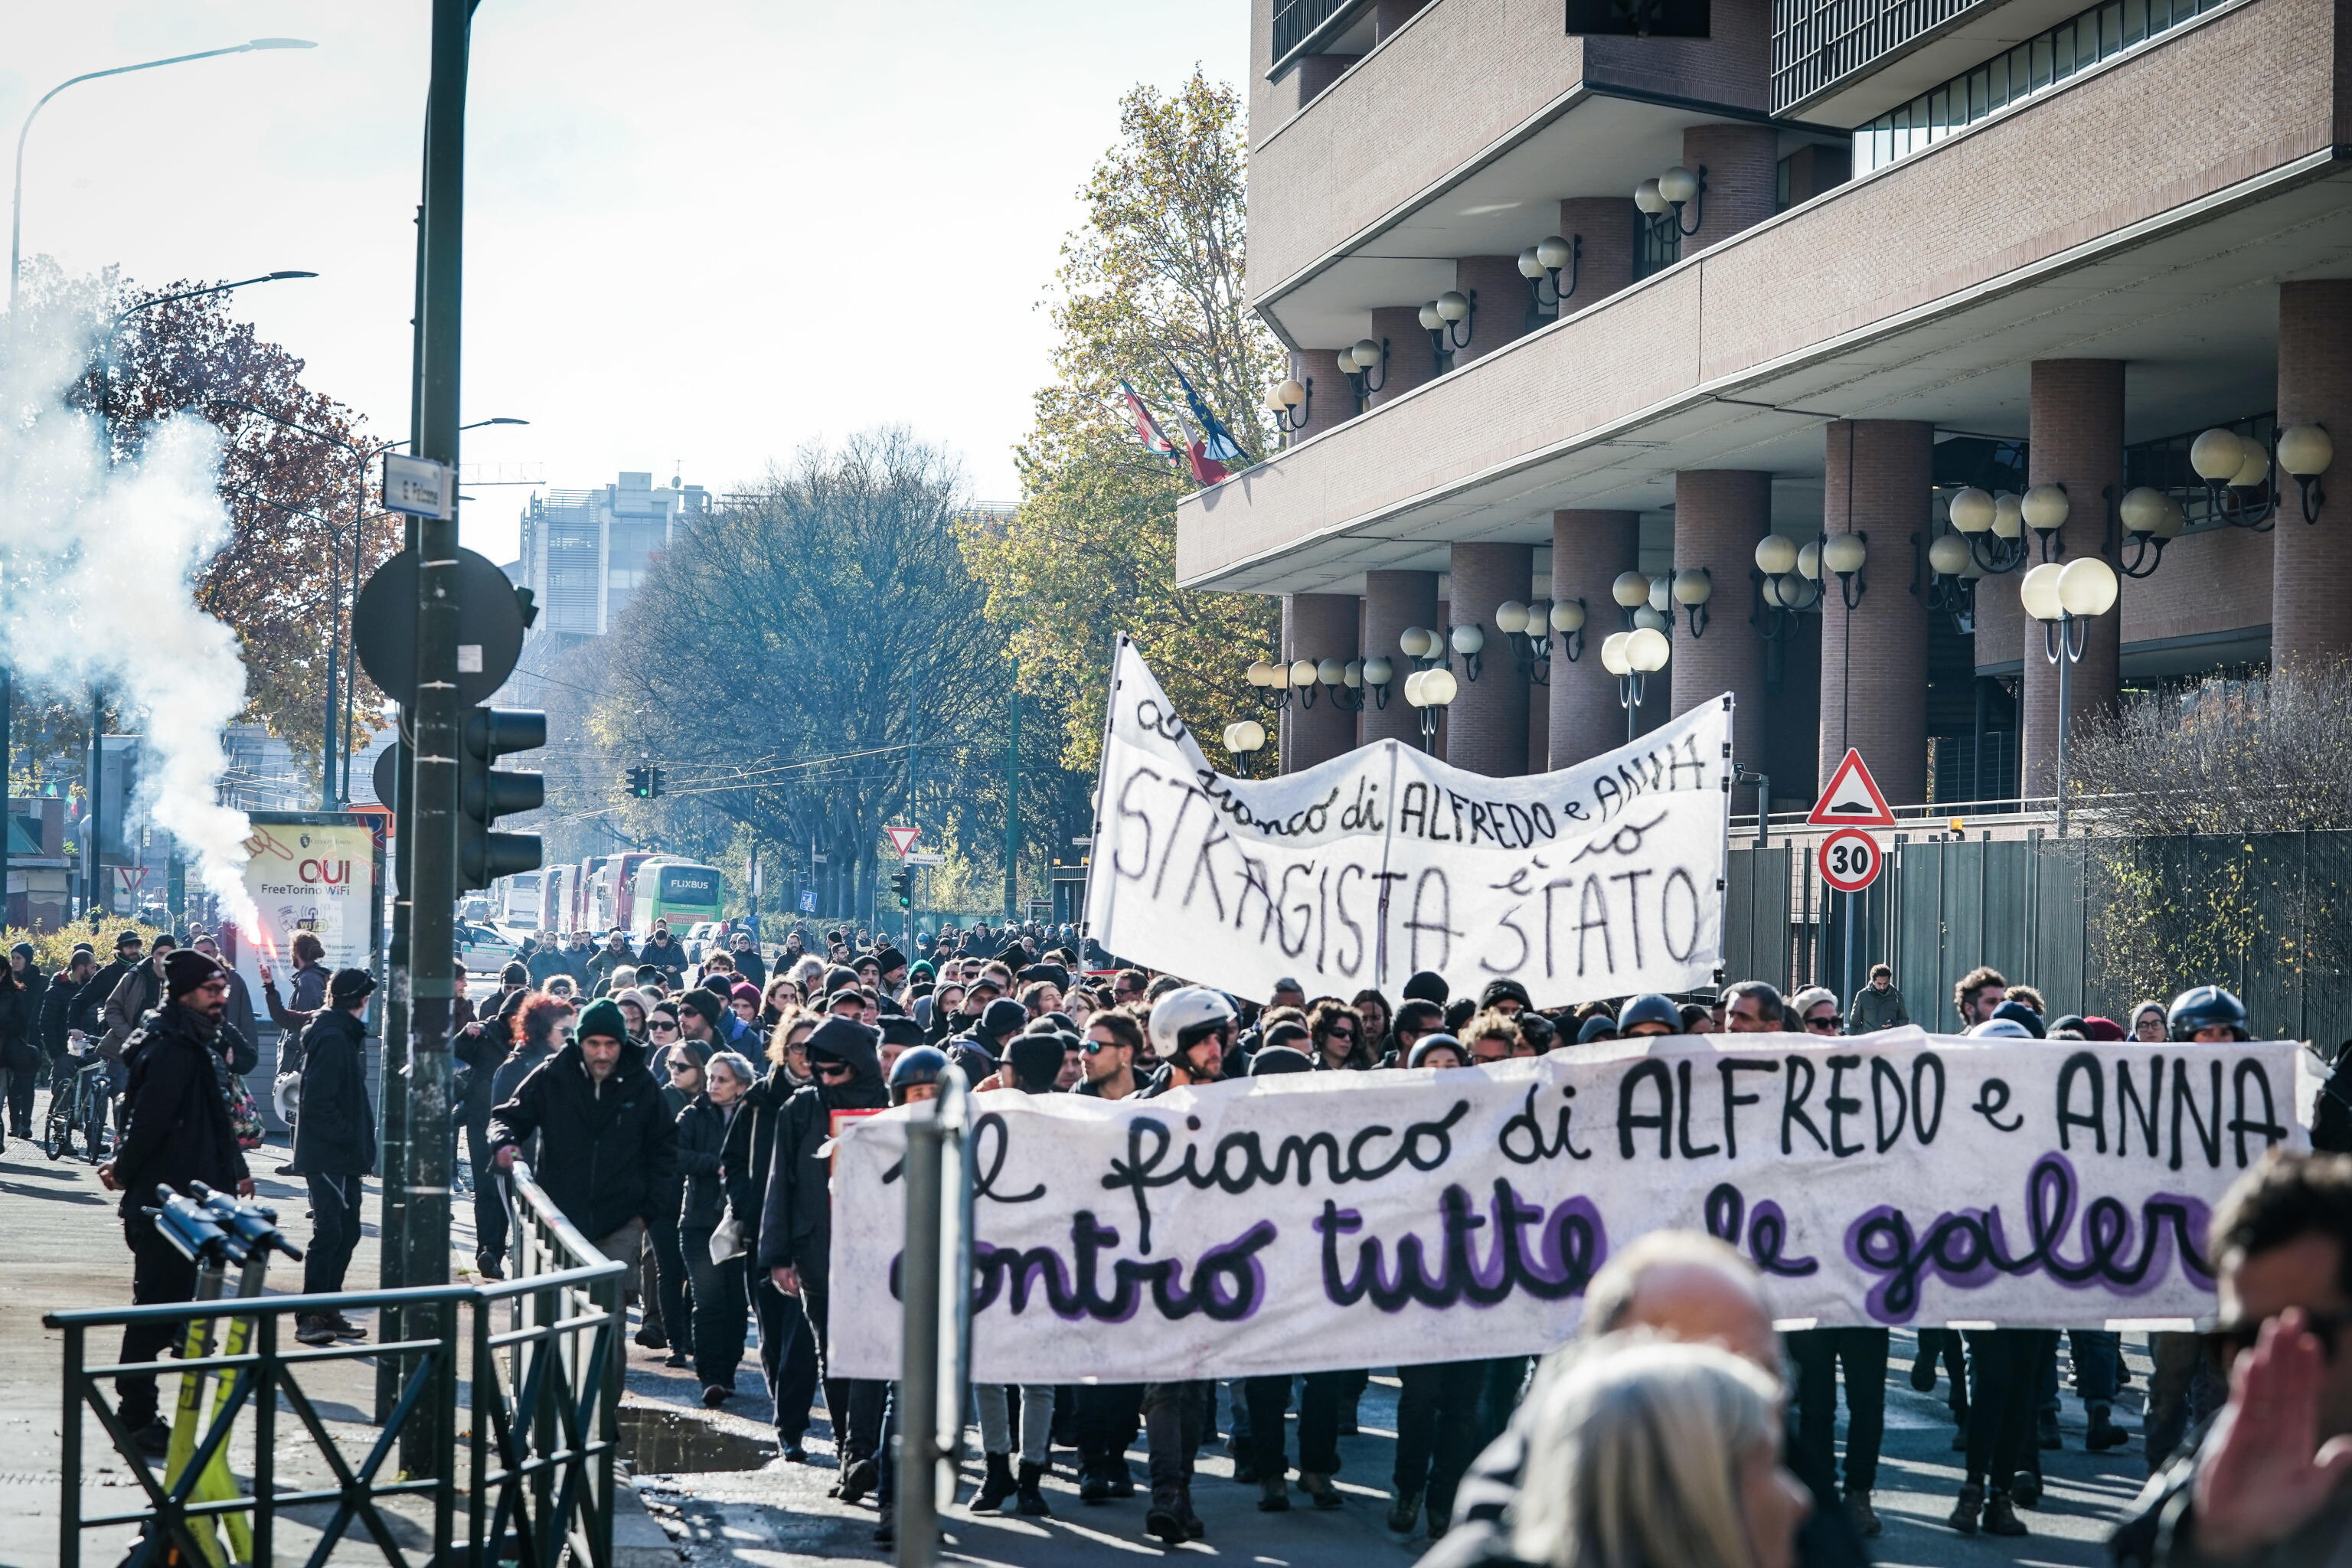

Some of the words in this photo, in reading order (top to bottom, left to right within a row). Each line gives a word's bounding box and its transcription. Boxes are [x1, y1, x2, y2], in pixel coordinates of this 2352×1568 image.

[1341, 776, 1384, 833] di
[1400, 781, 1557, 850] ALFREDO
[1564, 801, 1590, 821] e
[1593, 733, 1707, 822] ANNA
[299, 859, 351, 884] QUI
[326, 885, 350, 895] WiFi
[1831, 845, 1868, 874] 30
[1480, 867, 1699, 978] STATO
[882, 1112, 1046, 1204] l
[1101, 1099, 1469, 1256] fianco
[1498, 1083, 1592, 1164] di
[1618, 1052, 1945, 1161] ALFREDO
[1972, 1078, 2024, 1132] e
[2056, 1050, 2288, 1171] ANNA
[1313, 1176, 1607, 1312] tutte
[1704, 1181, 1818, 1278] le
